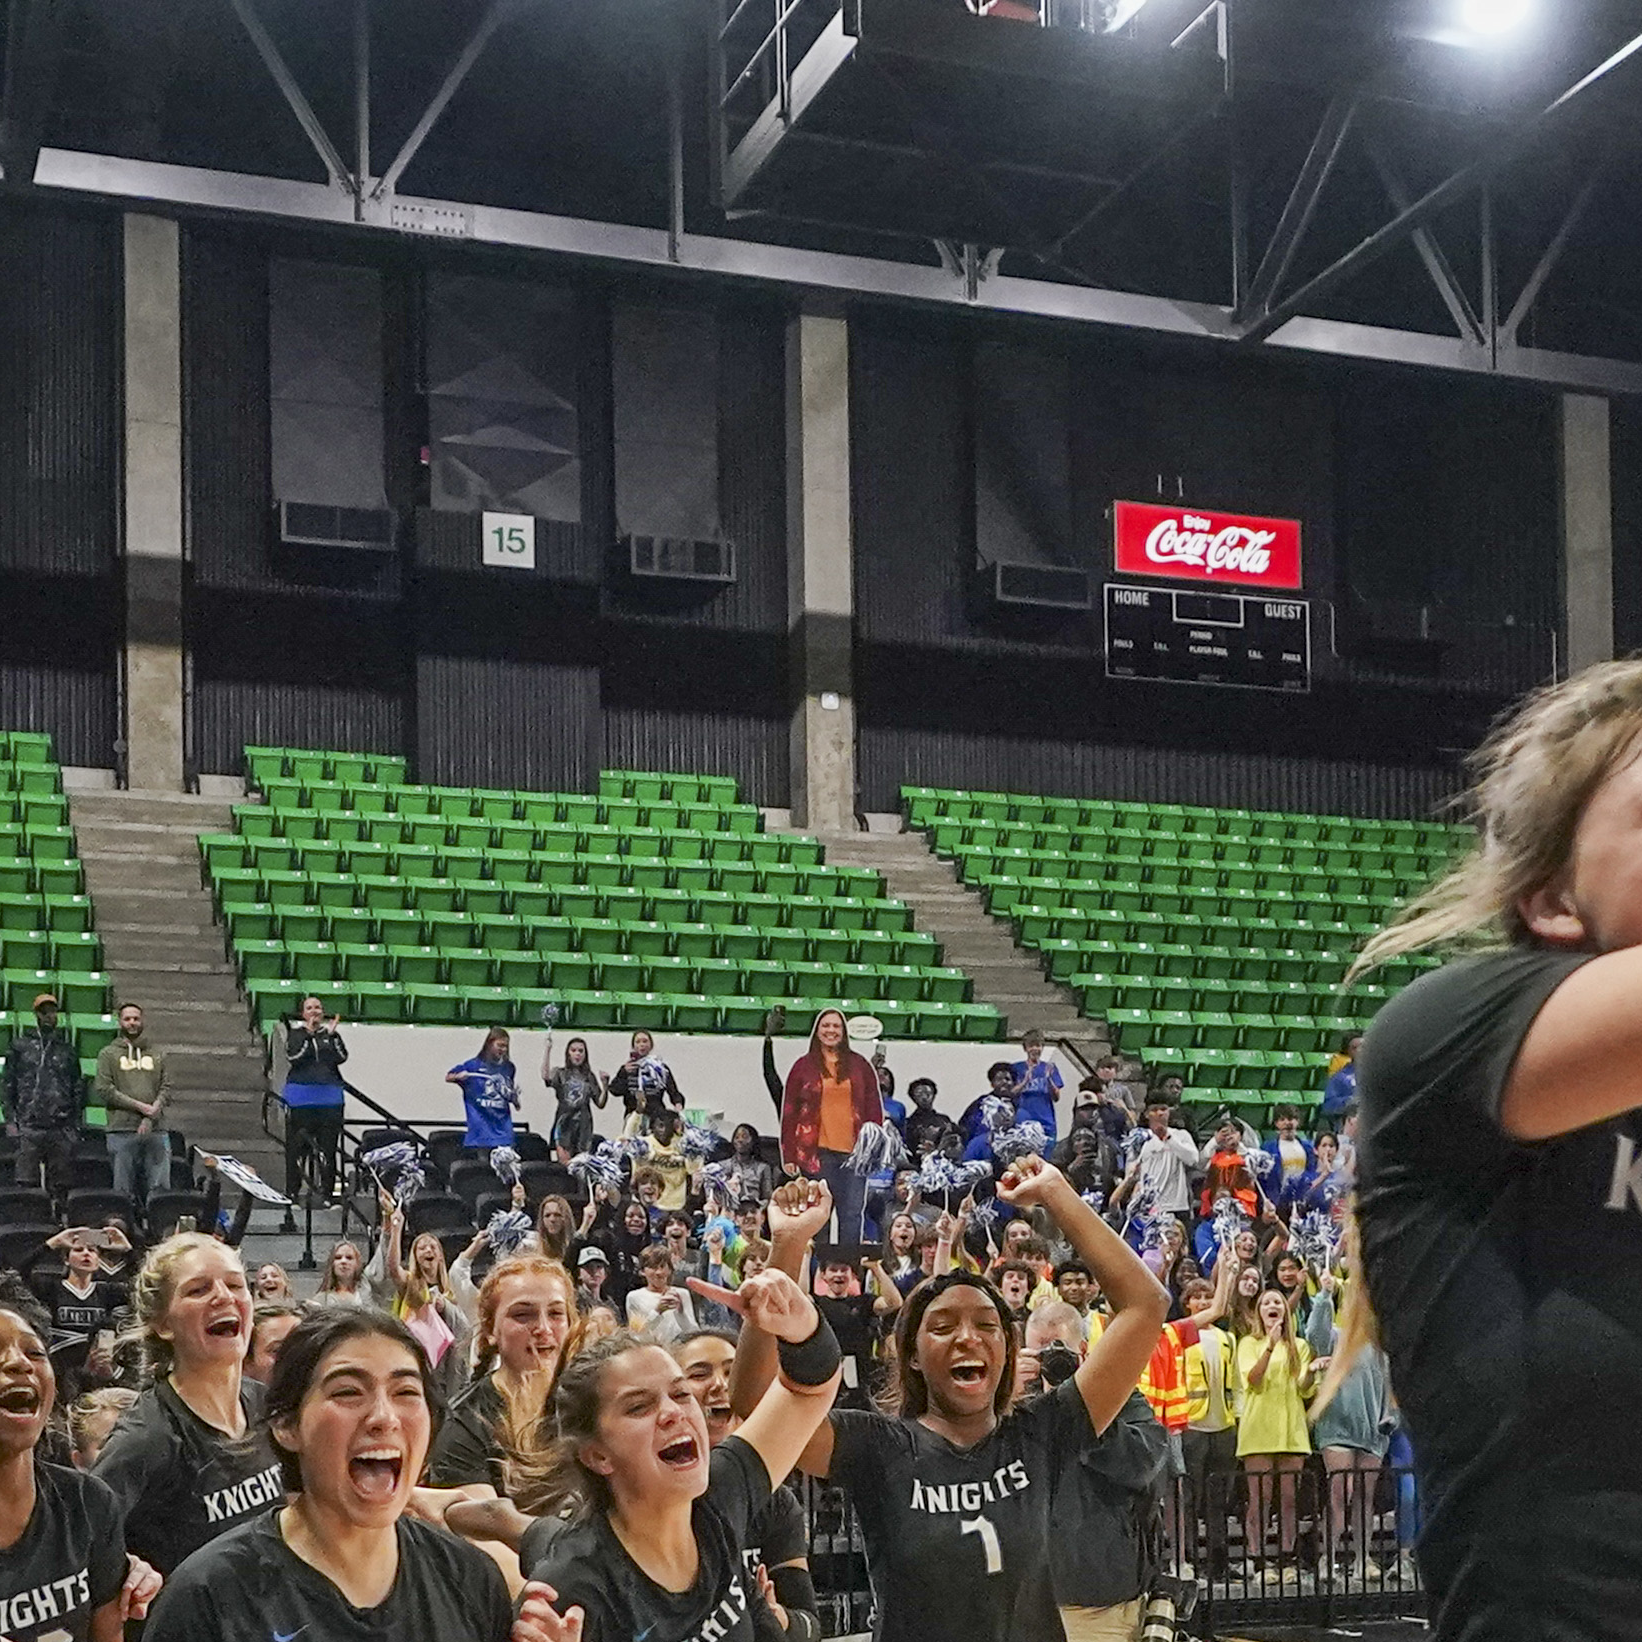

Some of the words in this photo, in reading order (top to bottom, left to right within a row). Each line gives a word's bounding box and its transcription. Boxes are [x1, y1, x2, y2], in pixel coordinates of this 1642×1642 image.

[492, 527, 526, 554] 15
[1145, 519, 1276, 574] Coca-Cola
[1114, 590, 1150, 606] HOME
[1264, 603, 1302, 620] GUEST
